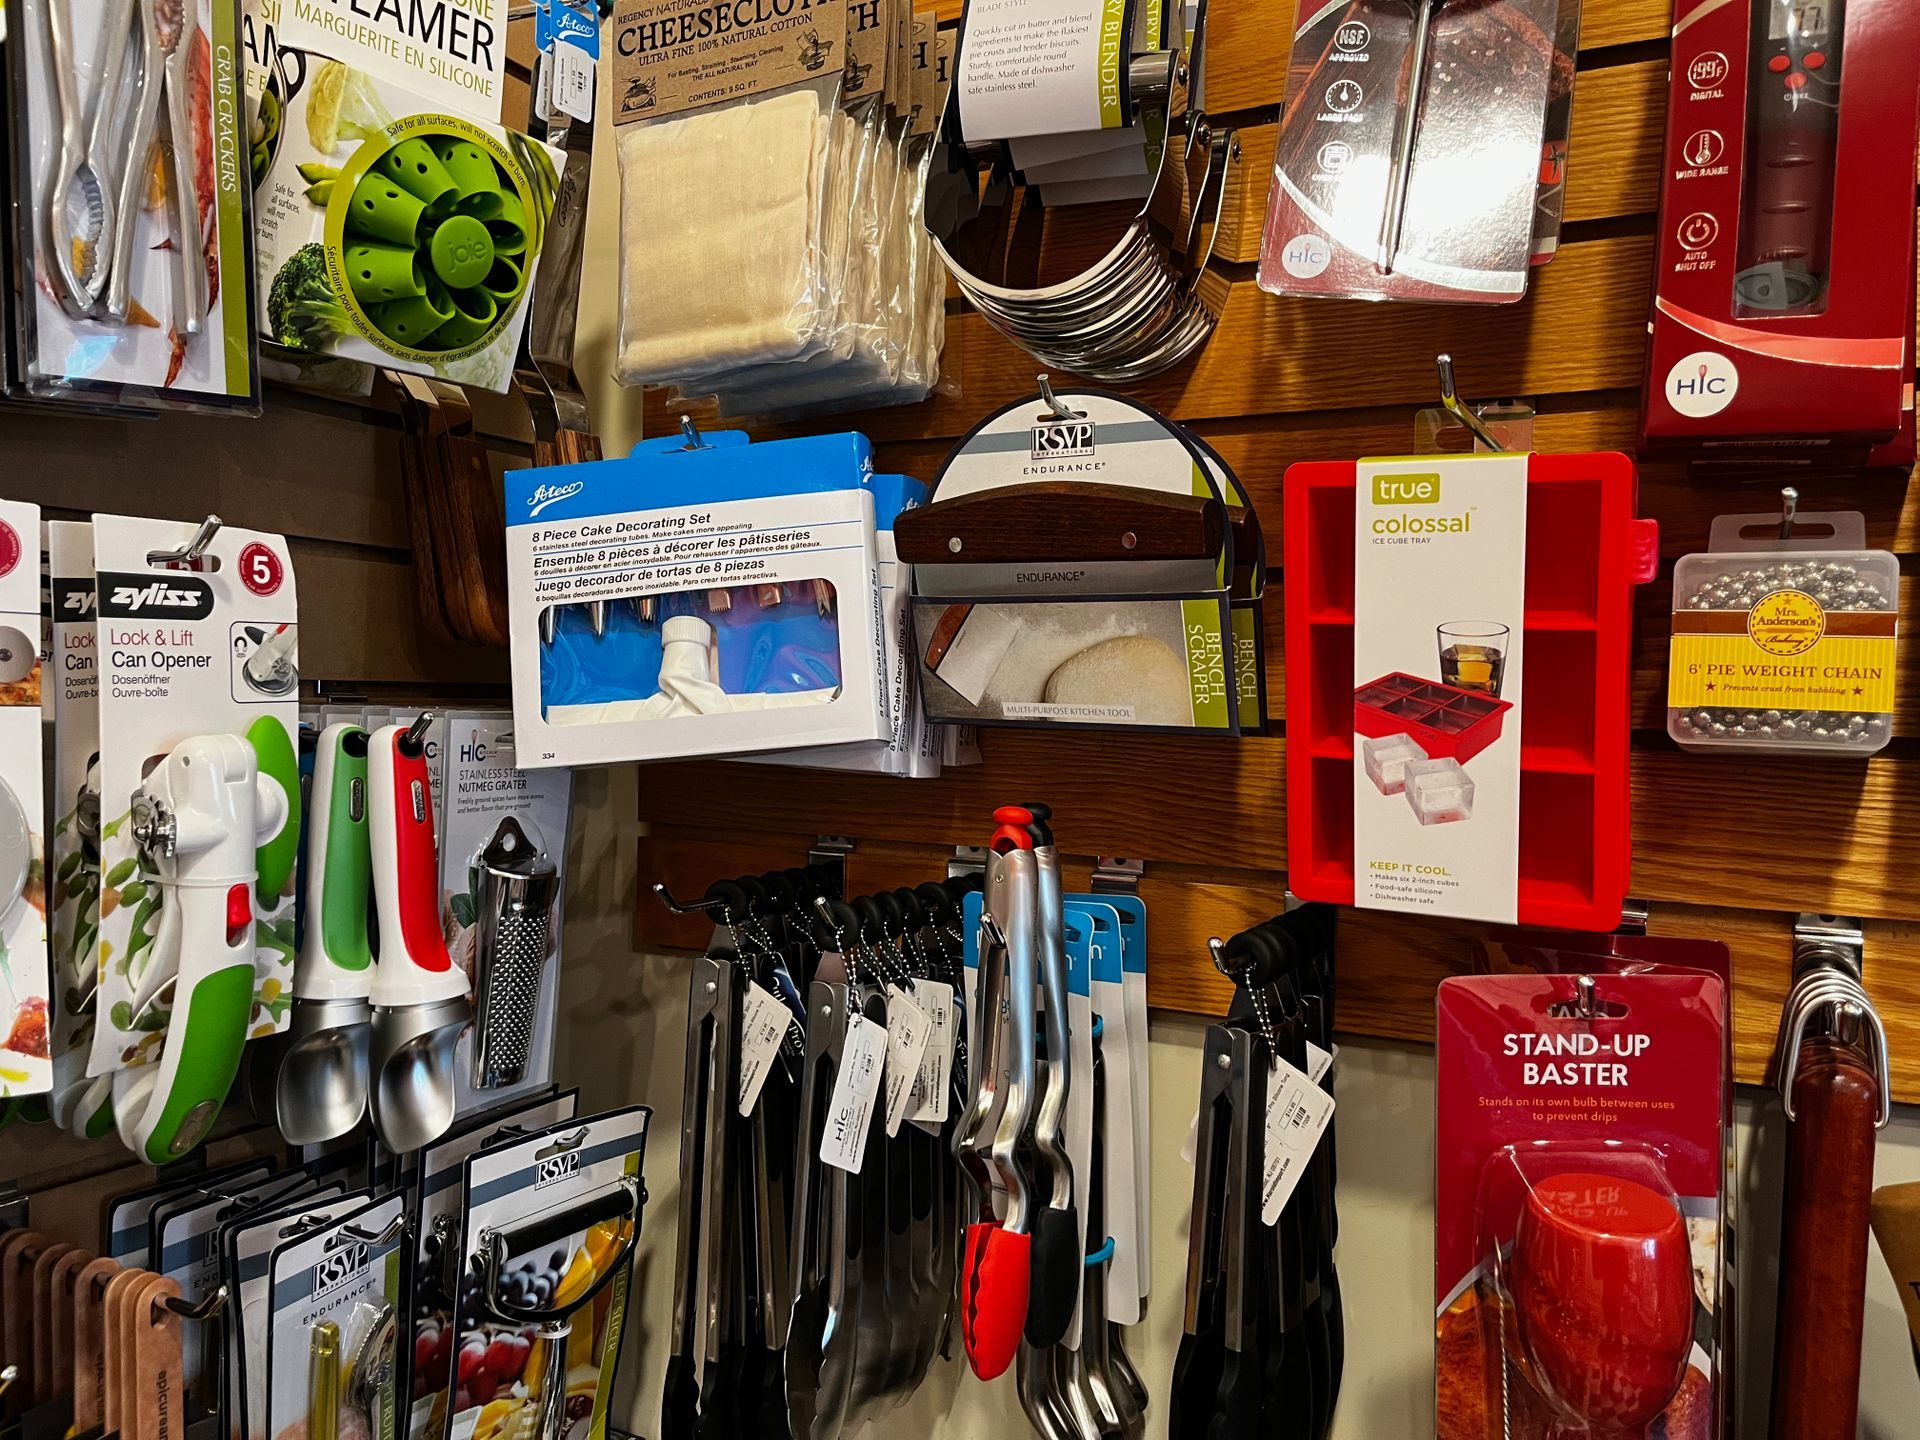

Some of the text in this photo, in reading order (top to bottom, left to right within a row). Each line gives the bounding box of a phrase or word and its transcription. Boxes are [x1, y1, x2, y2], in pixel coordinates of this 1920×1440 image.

[556, 13, 595, 37] Ateco
[618, 8, 654, 25] REGENCY
[639, 13, 812, 66] ULTRA FINE 100% NATURAL COTTON
[295, 2, 399, 59] MARGUERITE
[405, 46, 425, 75] EN
[429, 56, 493, 98] SILICONE
[996, 55, 1041, 67] comfortable
[1043, 51, 1067, 60] round
[1101, 21, 1120, 107] BLENDER
[717, 64, 743, 75] NATURAL
[998, 69, 1020, 79] Made
[1022, 67, 1029, 76] of
[1032, 63, 1075, 75] dishwasher
[689, 88, 727, 103] CONTENTS:
[968, 79, 1037, 95] safe stainless steel.
[1690, 89, 1724, 101] DIGITAL
[217, 45, 236, 192] CRAB CRACKERS
[387, 122, 403, 137] Safe
[404, 119, 414, 129] for
[427, 115, 458, 129] surfaces,
[461, 123, 472, 133] will
[474, 128, 486, 141] not
[487, 137, 508, 161] scratch
[1676, 166, 1729, 179] WIDE RANGE
[448, 237, 486, 273] joie
[1289, 243, 1322, 264] HIC
[1684, 251, 1708, 261] AUTO
[1674, 260, 1716, 272] SHUT OFF
[338, 293, 353, 313] pour
[351, 312, 369, 335] toutes
[368, 332, 394, 355] surfaces
[395, 349, 411, 360] sans
[413, 353, 438, 364] danger
[1677, 366, 1726, 397] HIC
[1035, 425, 1092, 453] RSVP
[527, 481, 584, 512] Ateco
[1380, 478, 1433, 499] true
[532, 513, 711, 542] 8 Piece Cake Decorating Set
[1372, 512, 1471, 533] colossal
[534, 530, 810, 568] Ensemble 8 pièces à décorer les pâtisseries
[1372, 537, 1431, 545] ICE CUBE TRAY
[253, 555, 270, 584] 5
[535, 560, 765, 592] Juego decorador de tortas de 8 piezas
[111, 583, 202, 611] zyliss
[1775, 608, 1799, 616] Mrs.
[1756, 616, 1816, 626] Anderson's
[65, 632, 96, 648] Lock
[111, 628, 194, 646] Lock & Lift
[1766, 634, 1805, 648] Baking
[65, 654, 92, 670] Can
[112, 651, 212, 672] Can Opener
[1188, 624, 1210, 704] SCRAPER
[1206, 632, 1225, 696] BENCH
[1240, 639, 1256, 697] BENCH
[112, 674, 171, 685] Dosenöffner
[1689, 664, 1882, 680] 6' PIE WEIGHT CHAIN
[112, 686, 169, 698] Ouvre-boîte
[1723, 683, 1847, 695] Prevents crust from bubbling
[1007, 705, 1132, 717] MULTI-PURPOSE KITCHEN TOOL
[460, 739, 487, 763] HIC
[542, 752, 555, 760] 334
[459, 767, 526, 781] STAINLESS STEEL
[459, 779, 527, 794] NUTMEG GRATER
[1370, 861, 1451, 876] KEEP IT COOL.
[1375, 884, 1442, 895] Food-safe silicone
[1412, 877, 1435, 885] 2-inch
[1375, 893, 1417, 902] Dishwasher
[1503, 1033, 1650, 1057] STAND-UP
[1523, 1063, 1629, 1086] BASTER
[1479, 1097, 1513, 1106] Stands
[1532, 1098, 1544, 1106] its
[1573, 1097, 1598, 1107] bulb
[1601, 1099, 1648, 1109] between
[1651, 1101, 1675, 1109] uses
[1532, 1112, 1617, 1123] to prevent drips
[537, 1152, 580, 1181] RSVP
[314, 1244, 369, 1291] RSVP
[607, 1306, 622, 1352] SLICER
